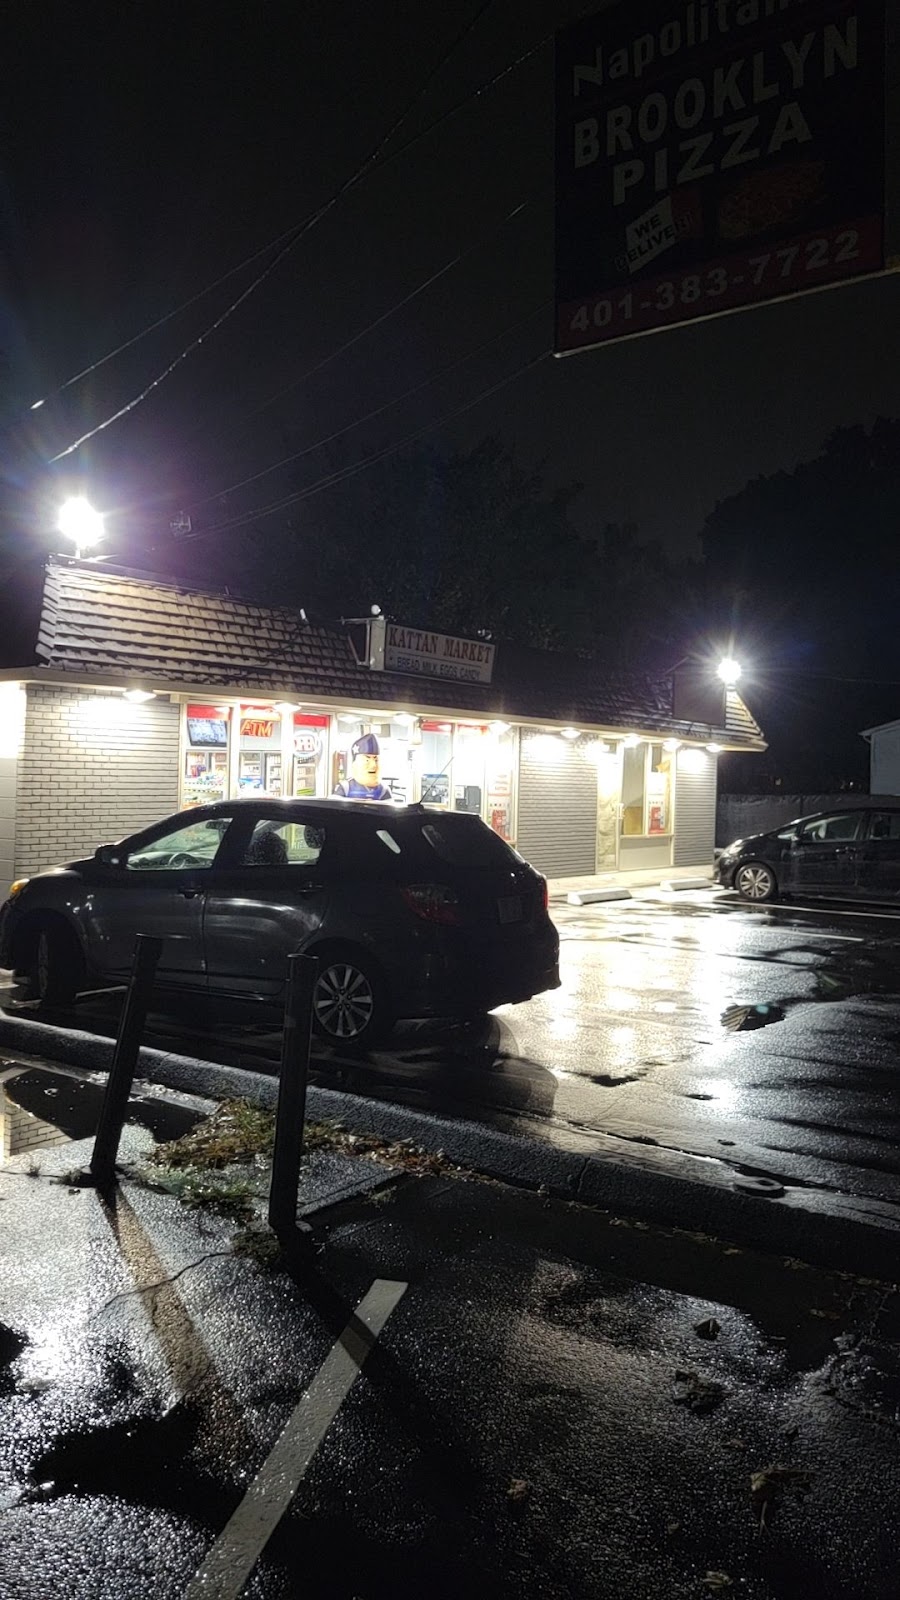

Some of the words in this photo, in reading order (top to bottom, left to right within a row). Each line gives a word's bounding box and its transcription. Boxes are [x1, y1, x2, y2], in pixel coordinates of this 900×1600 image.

[573, 16, 858, 169] BROOKLYN
[611, 101, 813, 206] PIZZA
[635, 214, 663, 241] WE
[570, 230, 859, 332] 401-383-7722
[388, 626, 439, 655] KATTAN
[443, 638, 492, 664] MARKET
[397, 656, 420, 671] BREAD
[422, 660, 438, 674] MILK
[440, 664, 457, 678] EGGS
[240, 720, 273, 738] ATM
